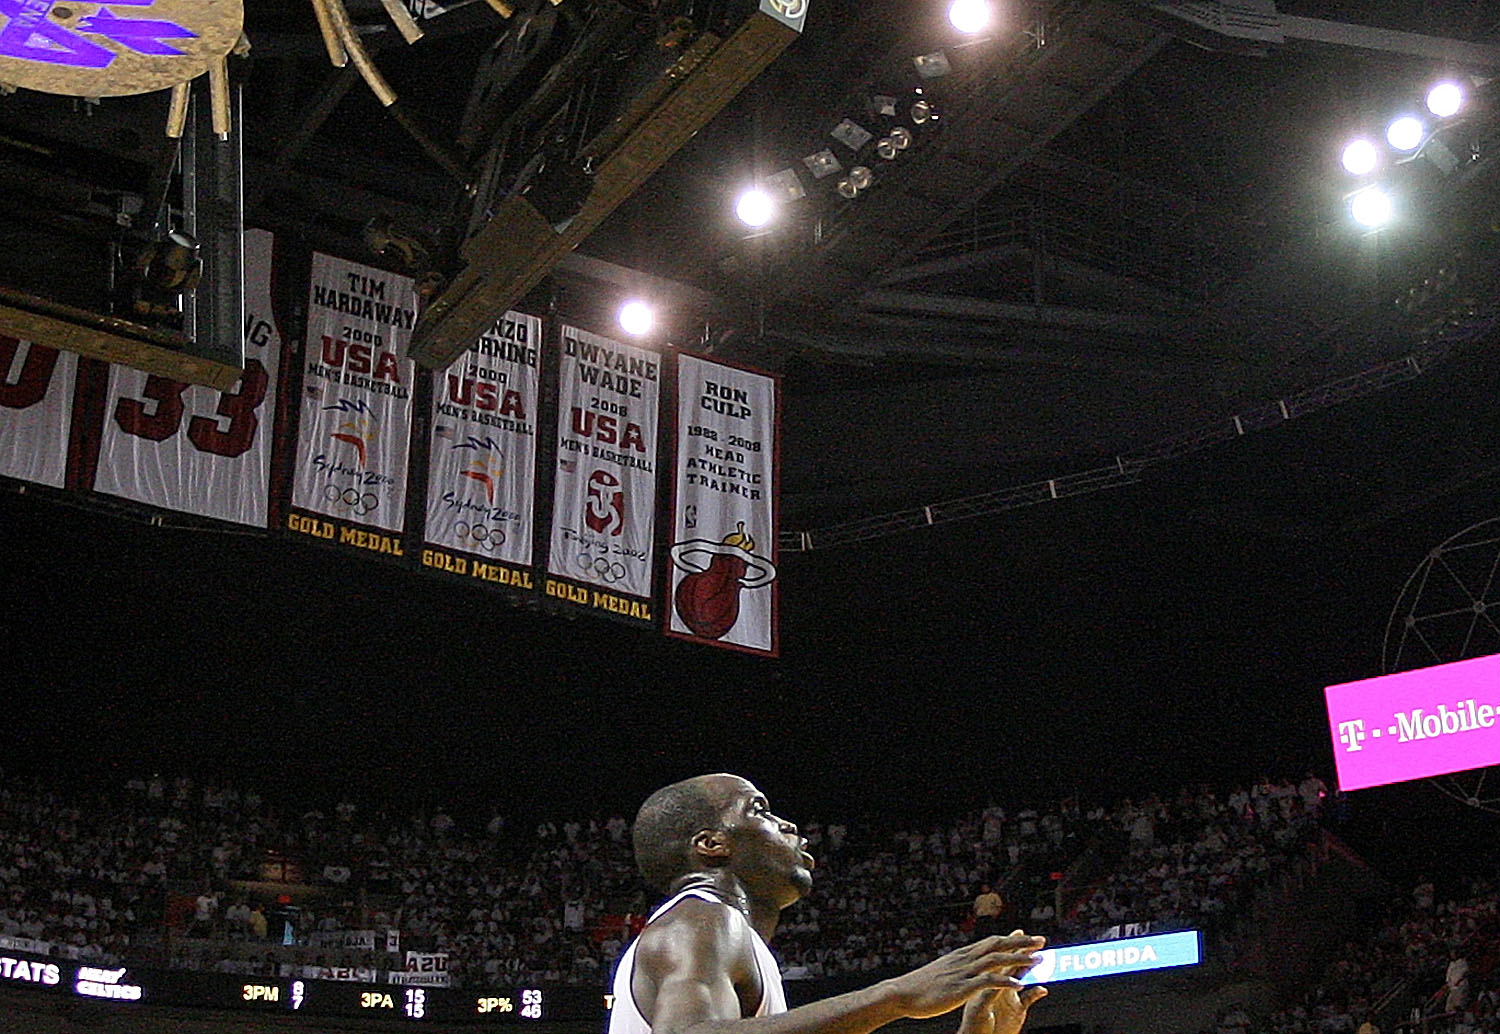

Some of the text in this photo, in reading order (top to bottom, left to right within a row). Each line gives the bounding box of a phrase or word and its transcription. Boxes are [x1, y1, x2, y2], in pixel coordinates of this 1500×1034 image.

[348, 273, 385, 300] TIM
[313, 285, 415, 330] HARDAWAY
[343, 327, 382, 346] 2000
[321, 335, 399, 384] USA
[565, 337, 657, 382] DWYANE
[345, 371, 409, 399] BASKETBALL
[579, 363, 642, 398] WADE
[705, 380, 748, 404] RON
[448, 374, 527, 420] USA
[591, 397, 628, 418] 2008
[701, 398, 751, 420] CULP
[472, 411, 534, 436] BASKETBALL
[571, 407, 647, 452] USA
[592, 446, 653, 473] BASKETBALL
[706, 444, 744, 464] HEAD
[687, 458, 761, 484] ATHLETIC
[687, 474, 760, 500] TRAINER
[443, 492, 493, 520] Sydney
[289, 514, 404, 556] GOLD MEDAL
[422, 550, 533, 590] GOLD MEDAL
[545, 580, 651, 621] GOLD MEDAL
[0, 957, 60, 985] TATS
[1059, 943, 1157, 973] FLORIDA
[243, 985, 279, 1001] 3PM
[361, 989, 425, 1008] 3PA 15
[477, 990, 543, 1013] 3P% 53
[405, 1003, 424, 1018] 15
